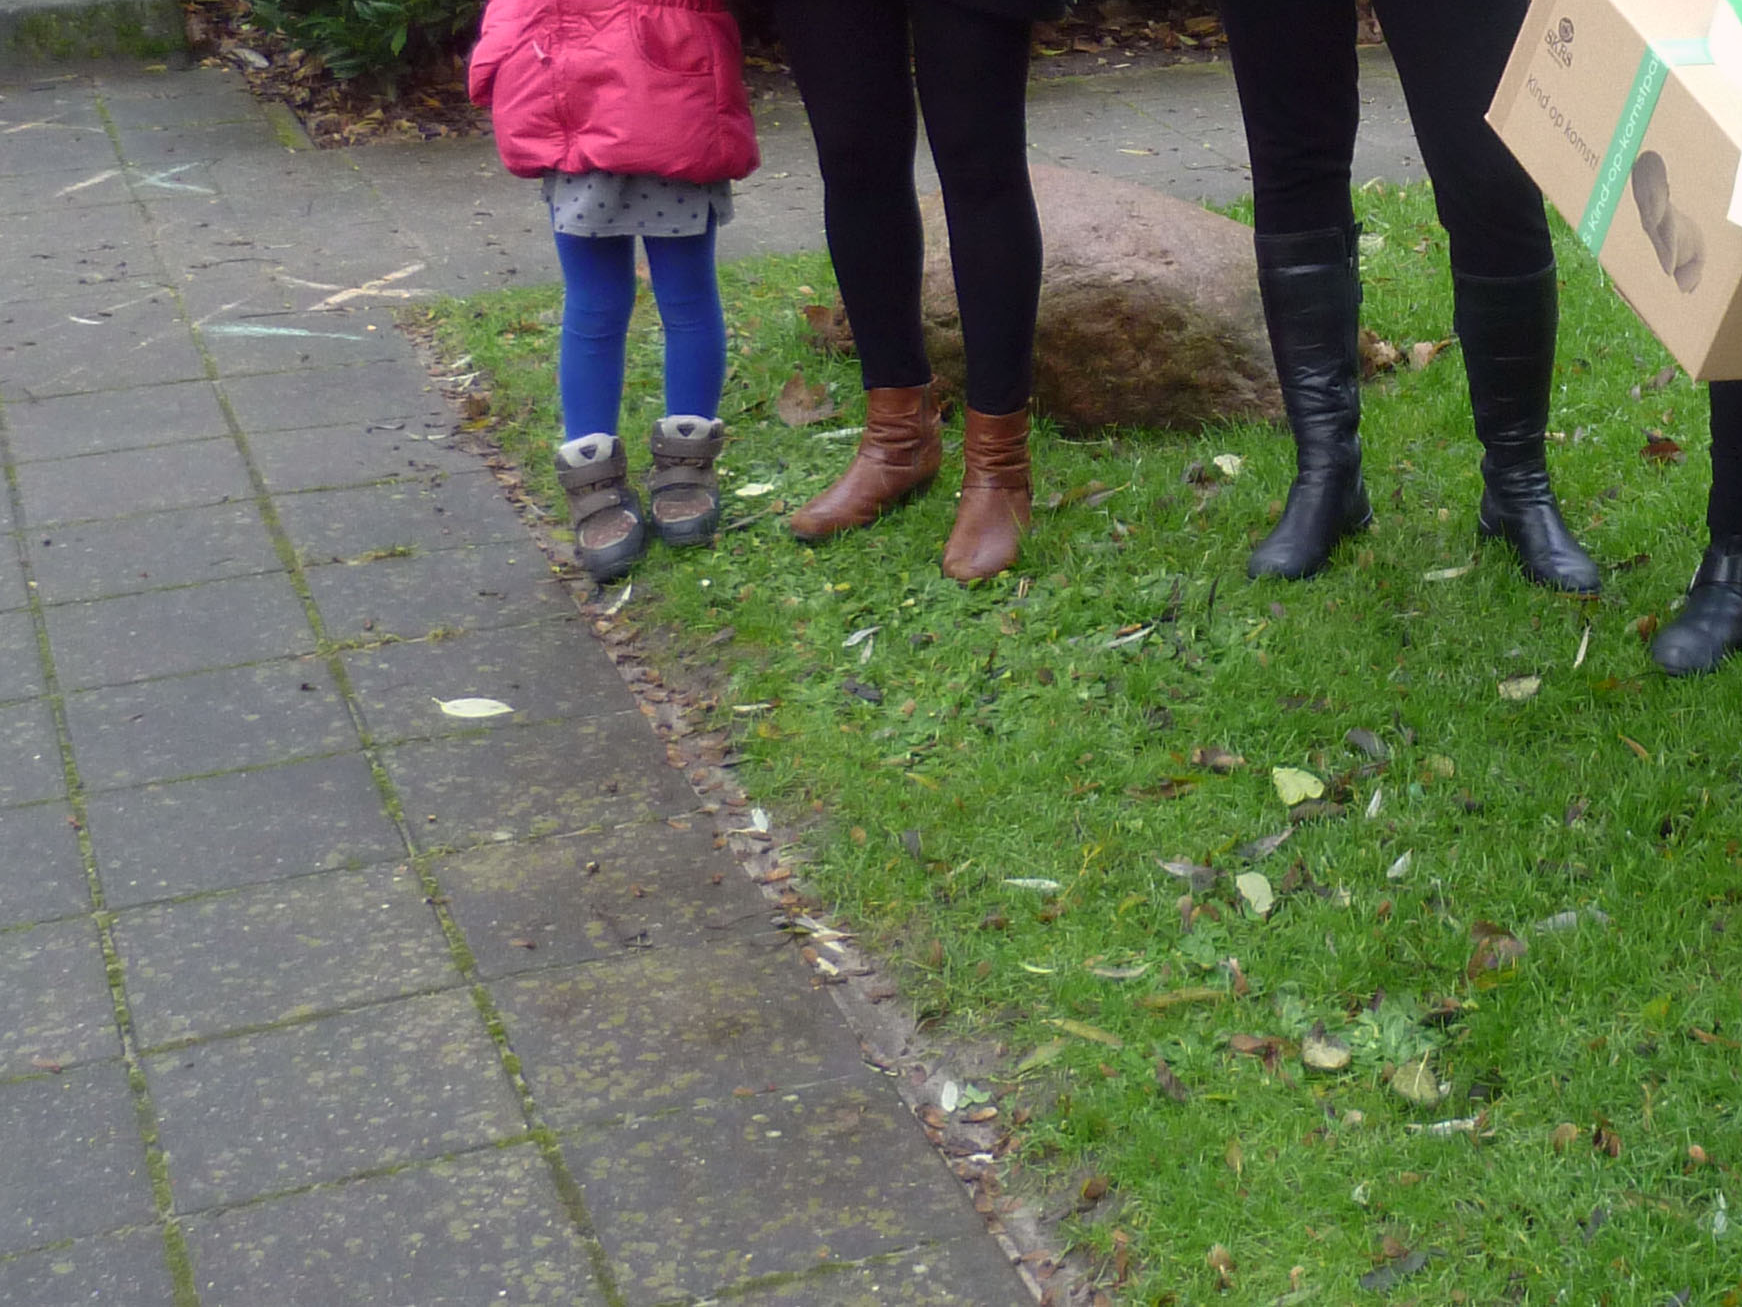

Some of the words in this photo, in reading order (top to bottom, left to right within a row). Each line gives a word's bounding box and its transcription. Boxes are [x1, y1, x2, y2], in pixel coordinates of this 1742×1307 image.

[1544, 28, 1573, 68] SKRS
[1526, 73, 1551, 110] Kind
[1549, 105, 1564, 129] op
